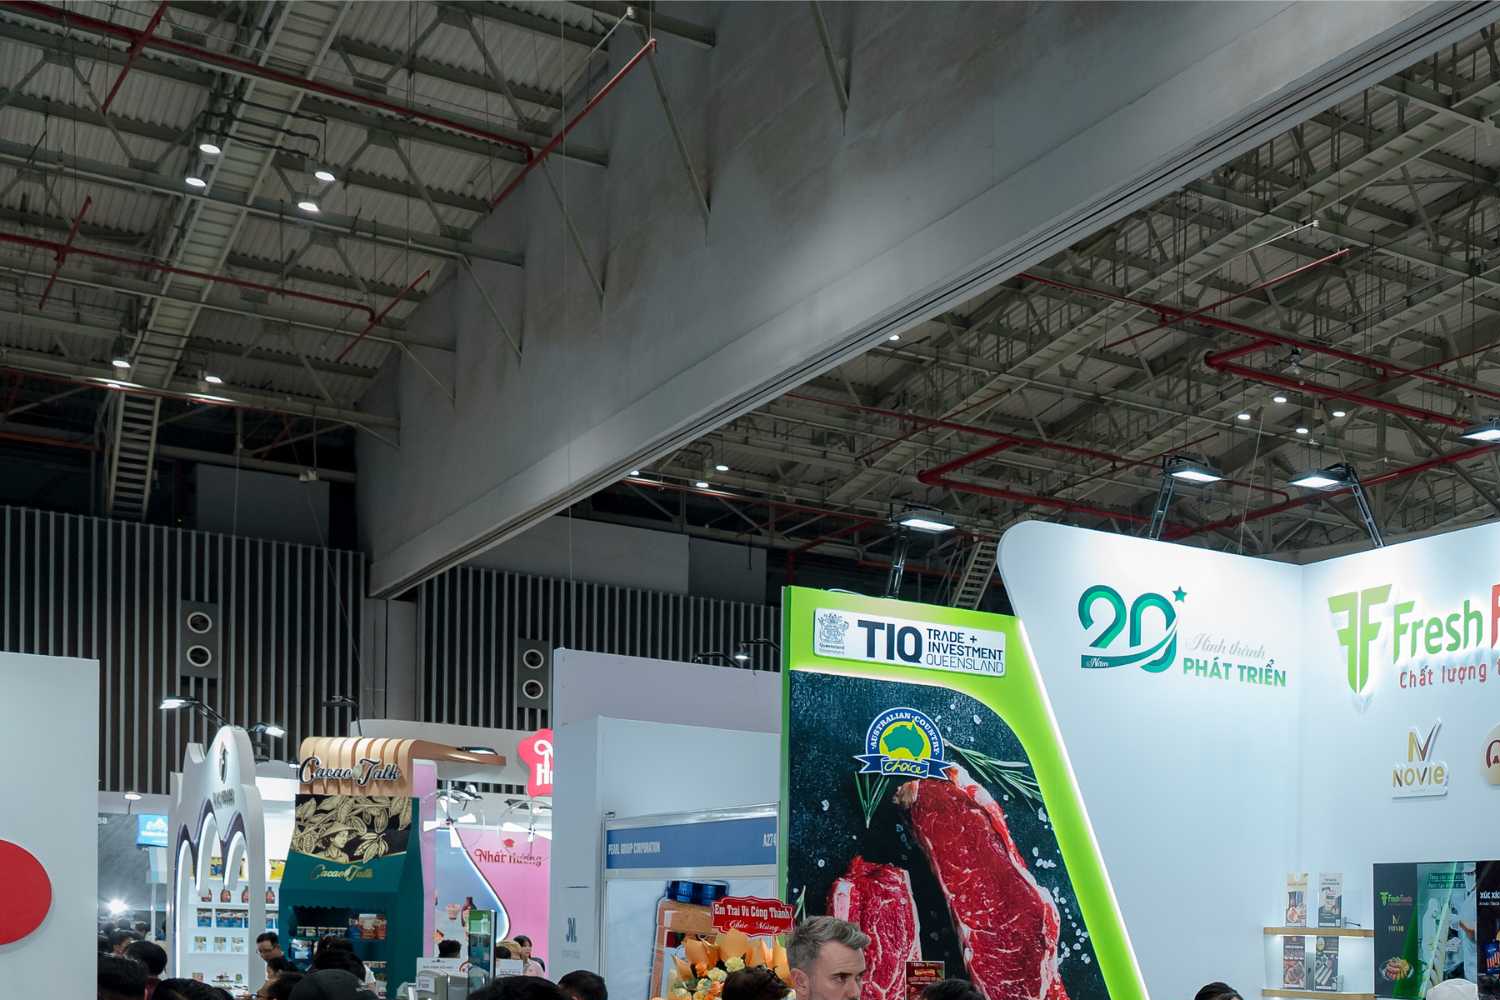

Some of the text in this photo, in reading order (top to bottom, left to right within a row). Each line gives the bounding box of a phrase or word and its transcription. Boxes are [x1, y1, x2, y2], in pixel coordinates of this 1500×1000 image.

[858, 619, 923, 664] TIQ
[926, 628, 965, 644] TRADE
[1078, 584, 1177, 673] 20
[926, 653, 1004, 673] QUEENSLAND
[928, 641, 1003, 660] INVESTMENT
[1183, 656, 1287, 687] PHÁT TRIỂN
[1399, 664, 1433, 689] Chất
[1442, 662, 1487, 685] lượng
[870, 712, 940, 753] AUSTRALIAN COUNTRY
[300, 756, 400, 785] Cacao Talk
